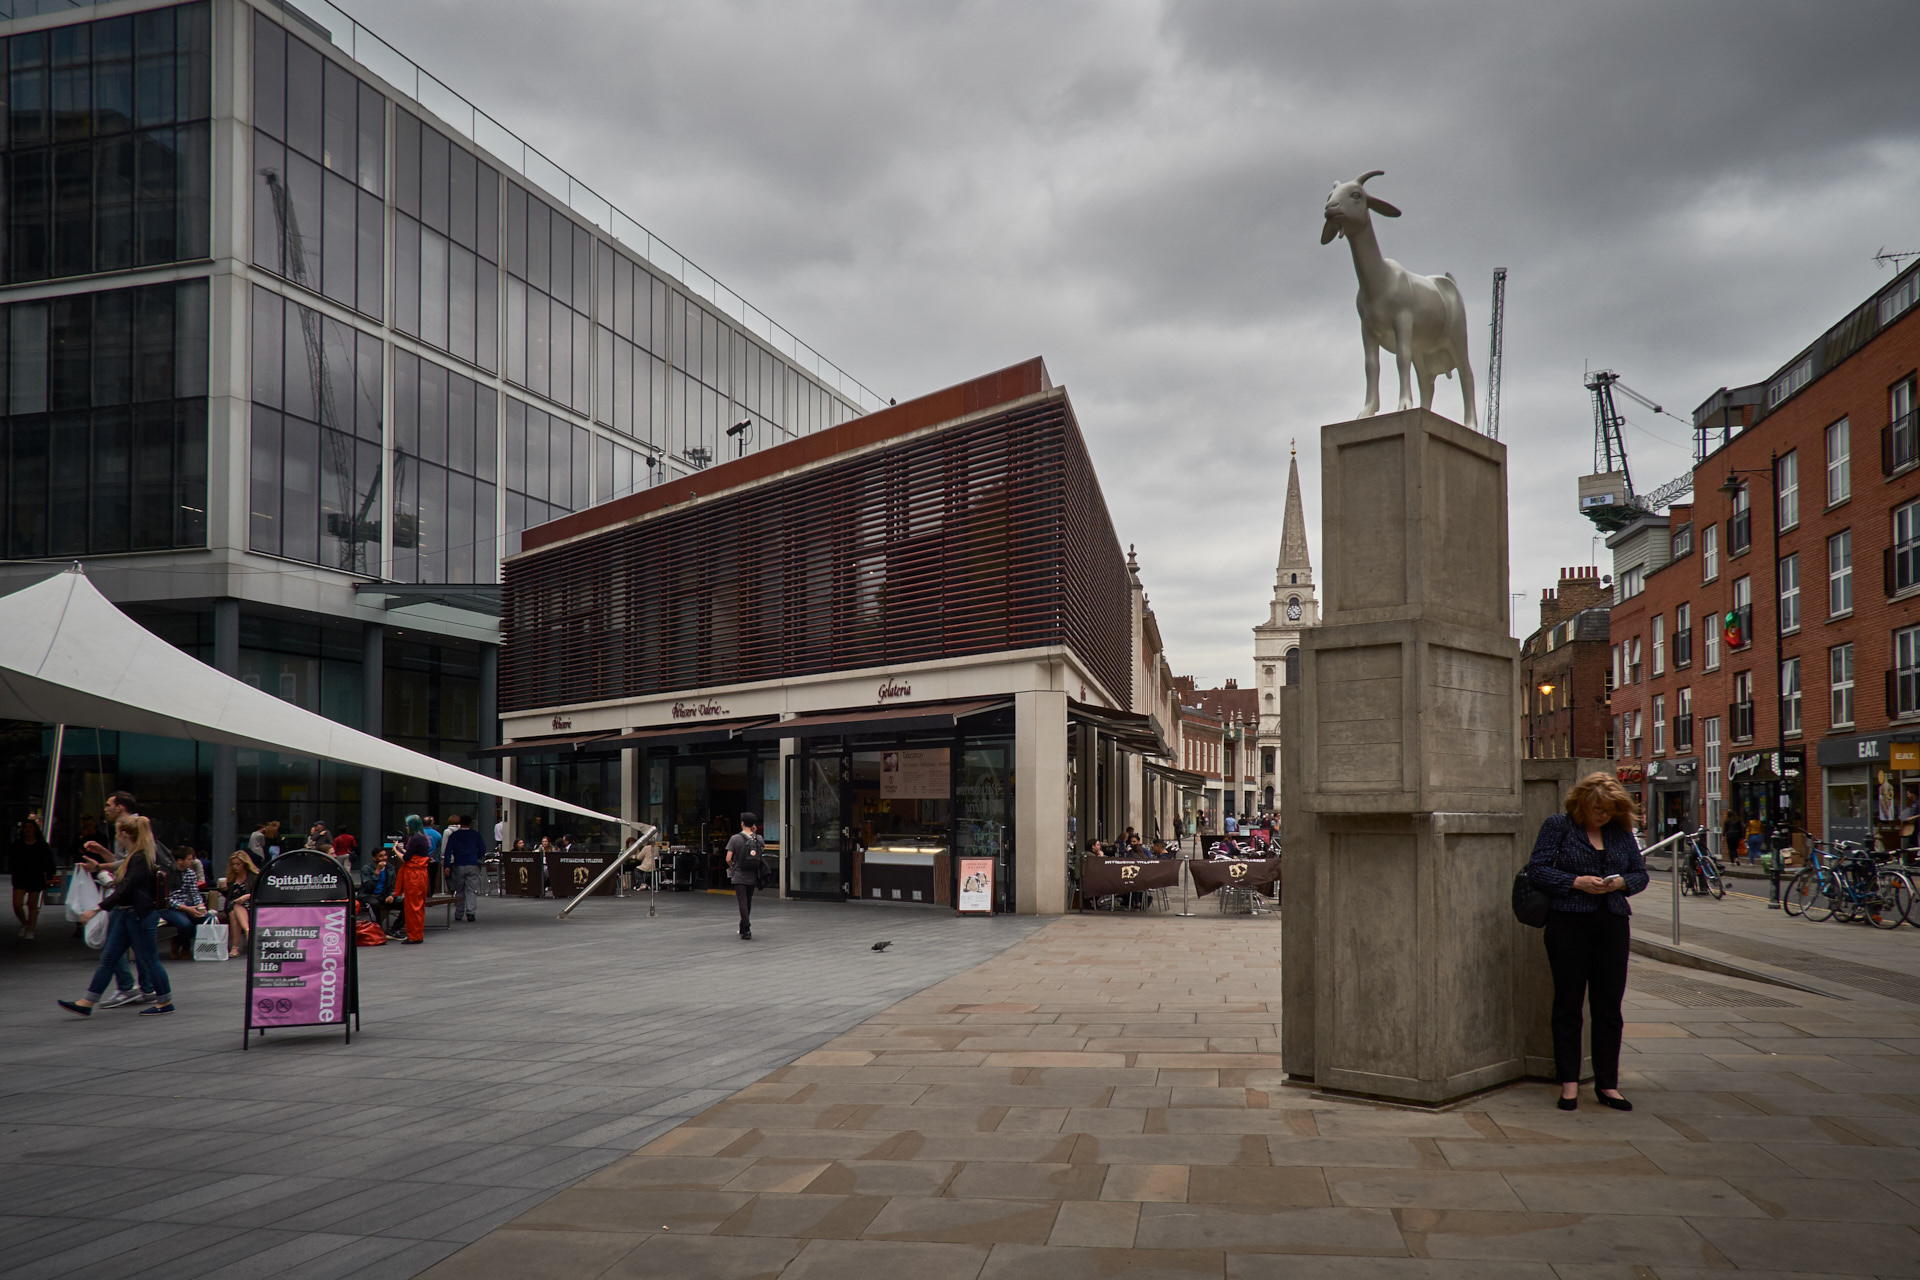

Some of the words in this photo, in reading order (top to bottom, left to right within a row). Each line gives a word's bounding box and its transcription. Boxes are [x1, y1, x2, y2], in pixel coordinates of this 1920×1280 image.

[878, 677, 911, 703] Gelateria
[1858, 740, 1879, 758] EAT.
[1895, 752, 1916, 760] EAT.
[1728, 753, 1760, 780] Chilango
[267, 873, 338, 888] Spitalfields
[280, 883, 338, 891] www.spitalfields.co.uk
[262, 928, 271, 937] A
[274, 928, 318, 939] melting
[262, 940, 280, 950] pot
[283, 939, 296, 948] of
[261, 951, 303, 960] London
[260, 962, 278, 971] life
[319, 909, 345, 1023] Welcome
